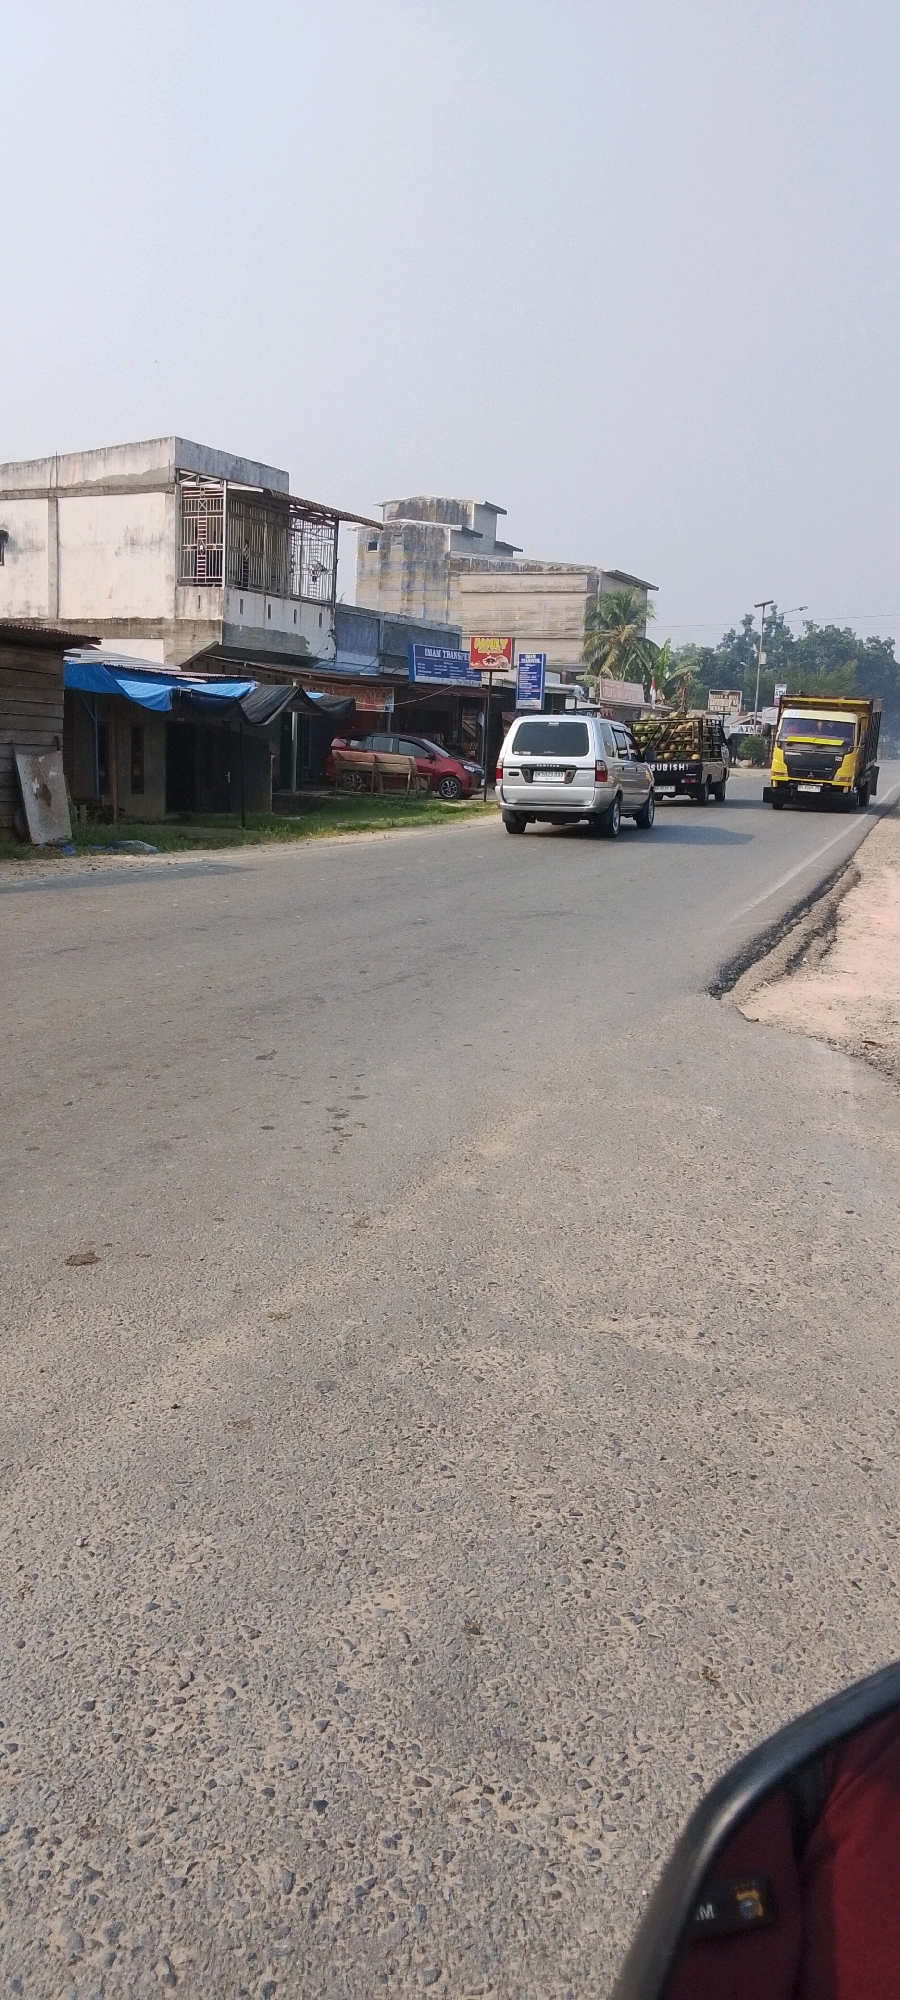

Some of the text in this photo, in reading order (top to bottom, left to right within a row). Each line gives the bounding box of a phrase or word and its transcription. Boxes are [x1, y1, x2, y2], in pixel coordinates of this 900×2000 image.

[474, 637, 508, 650] FAMILY
[425, 648, 441, 658] IMAM
[442, 650, 470, 661] TRANSFE
[649, 763, 689, 772] SUBISHI
